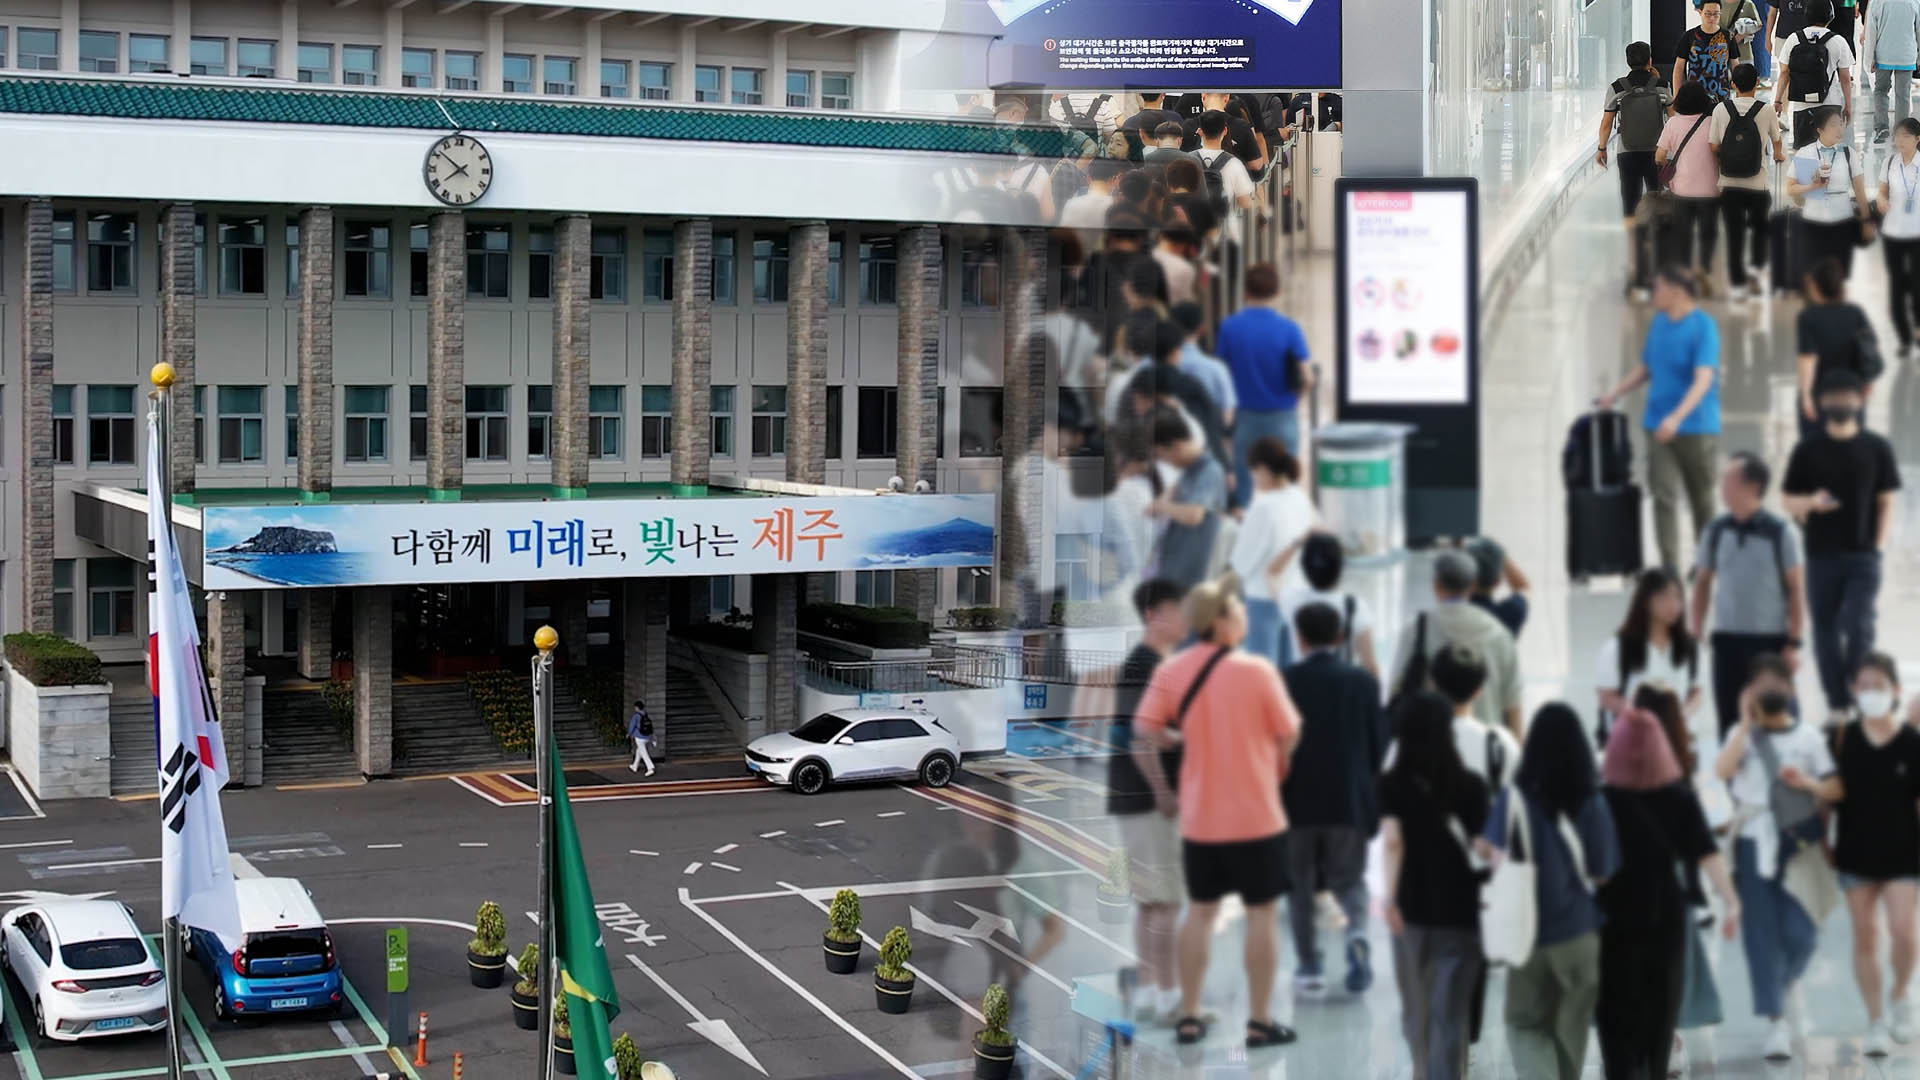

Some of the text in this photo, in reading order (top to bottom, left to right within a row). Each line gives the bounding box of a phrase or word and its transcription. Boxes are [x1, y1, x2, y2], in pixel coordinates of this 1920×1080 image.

[391, 507, 844, 569] 다함께 미래로, 빛나는 제주
